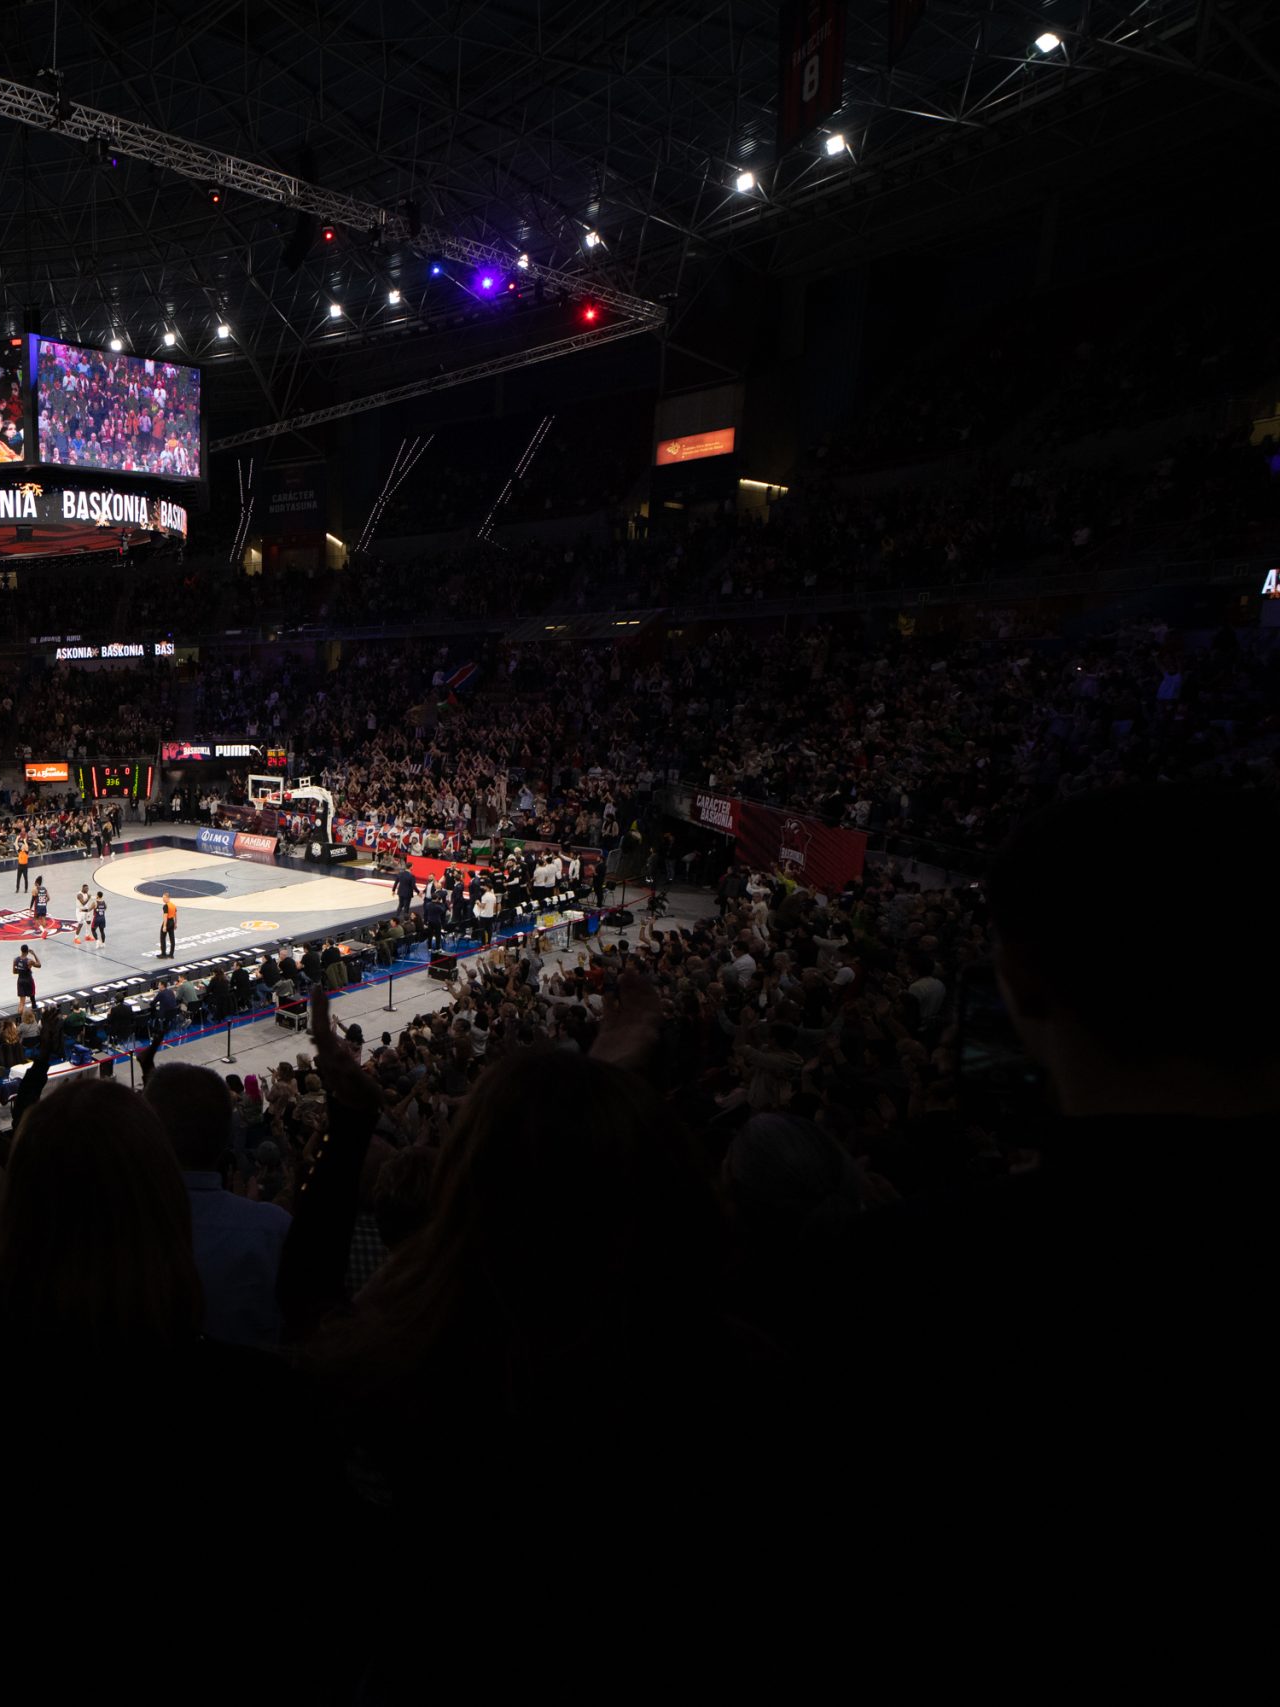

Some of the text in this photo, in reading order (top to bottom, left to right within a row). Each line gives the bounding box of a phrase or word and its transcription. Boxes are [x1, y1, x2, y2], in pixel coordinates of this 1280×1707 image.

[802, 55, 819, 103] 8
[63, 490, 149, 524] BASKONIA
[101, 644, 144, 658] BASKONIA
[215, 745, 251, 757] PUMA
[209, 833, 230, 846] IMQ
